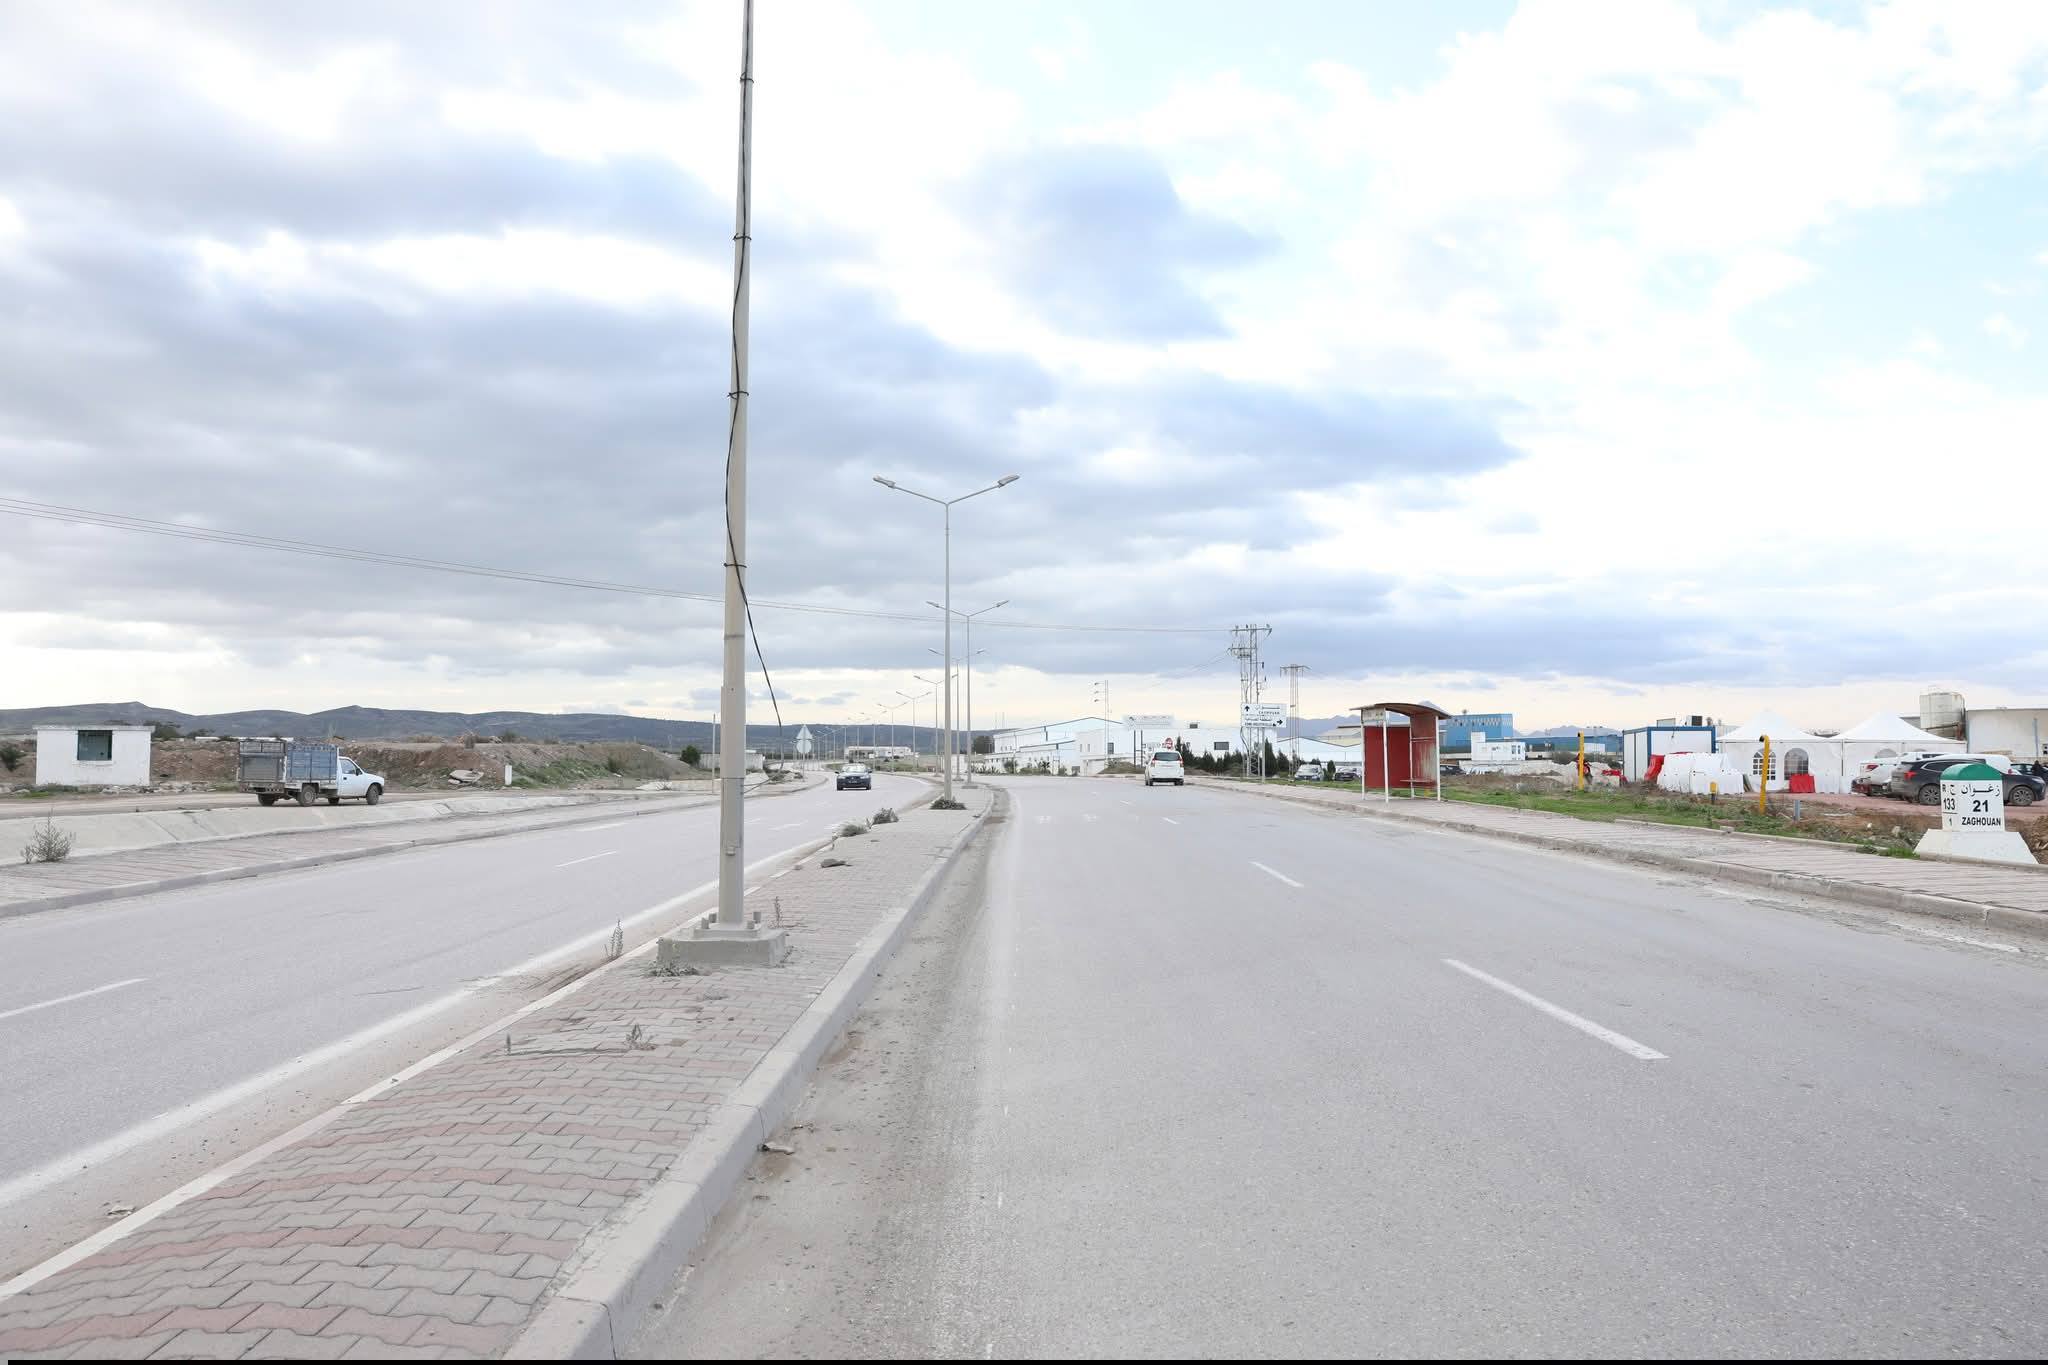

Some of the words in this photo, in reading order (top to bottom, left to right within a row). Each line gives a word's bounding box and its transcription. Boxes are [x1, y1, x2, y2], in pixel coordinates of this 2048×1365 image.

[1943, 798, 1956, 810] 133
[1973, 800, 1988, 812] 21
[1961, 817, 2001, 826] ZAGHOUAN
